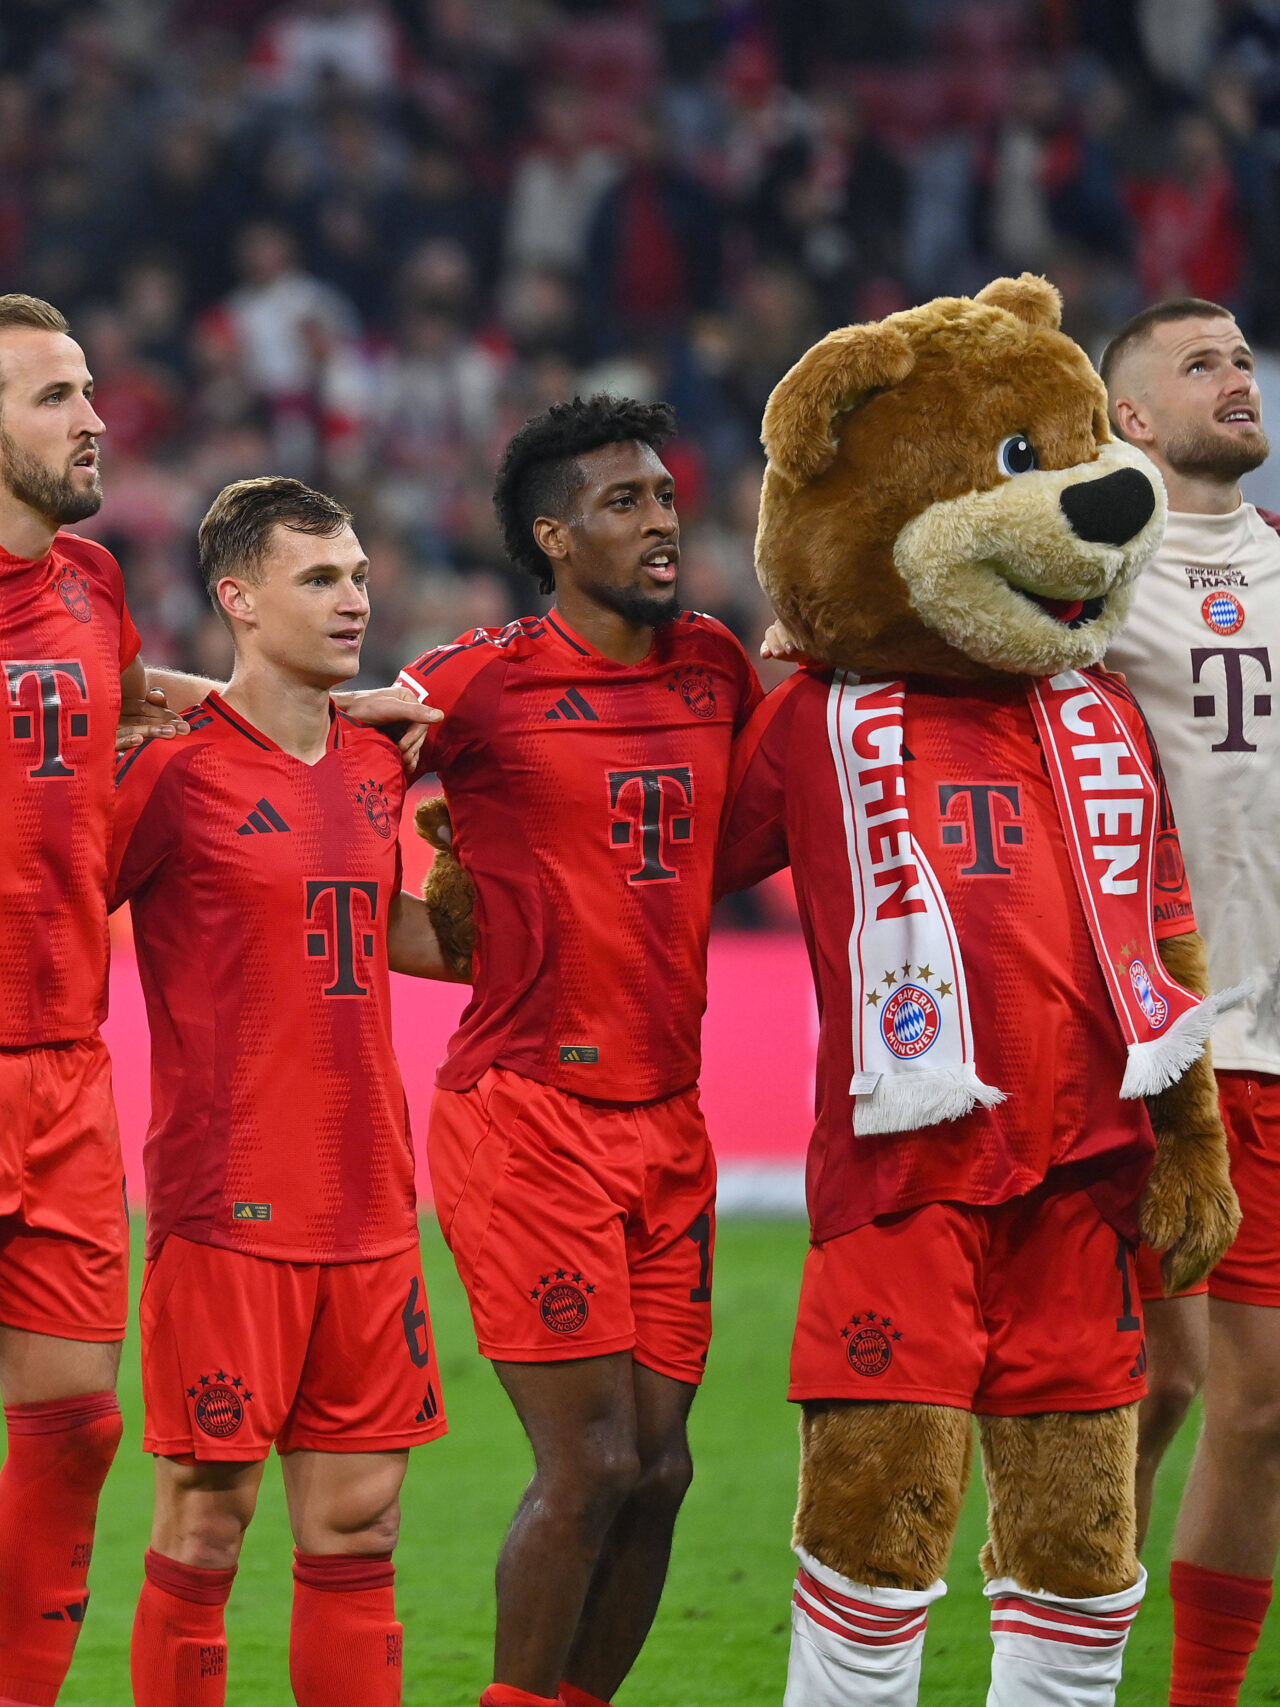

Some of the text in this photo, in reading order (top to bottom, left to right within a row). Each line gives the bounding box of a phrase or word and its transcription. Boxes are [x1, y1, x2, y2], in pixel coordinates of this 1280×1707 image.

[1189, 575, 1248, 589] FRANZ
[1, 659, 91, 782] T
[1190, 647, 1272, 752] T
[604, 762, 695, 886] T
[934, 781, 1024, 880] T
[303, 876, 379, 999] T
[886, 989, 934, 1019] FC BAYERN
[402, 1275, 429, 1369] 6
[552, 1287, 584, 1305] BAYERN
[209, 1390, 240, 1410] BAYERN
